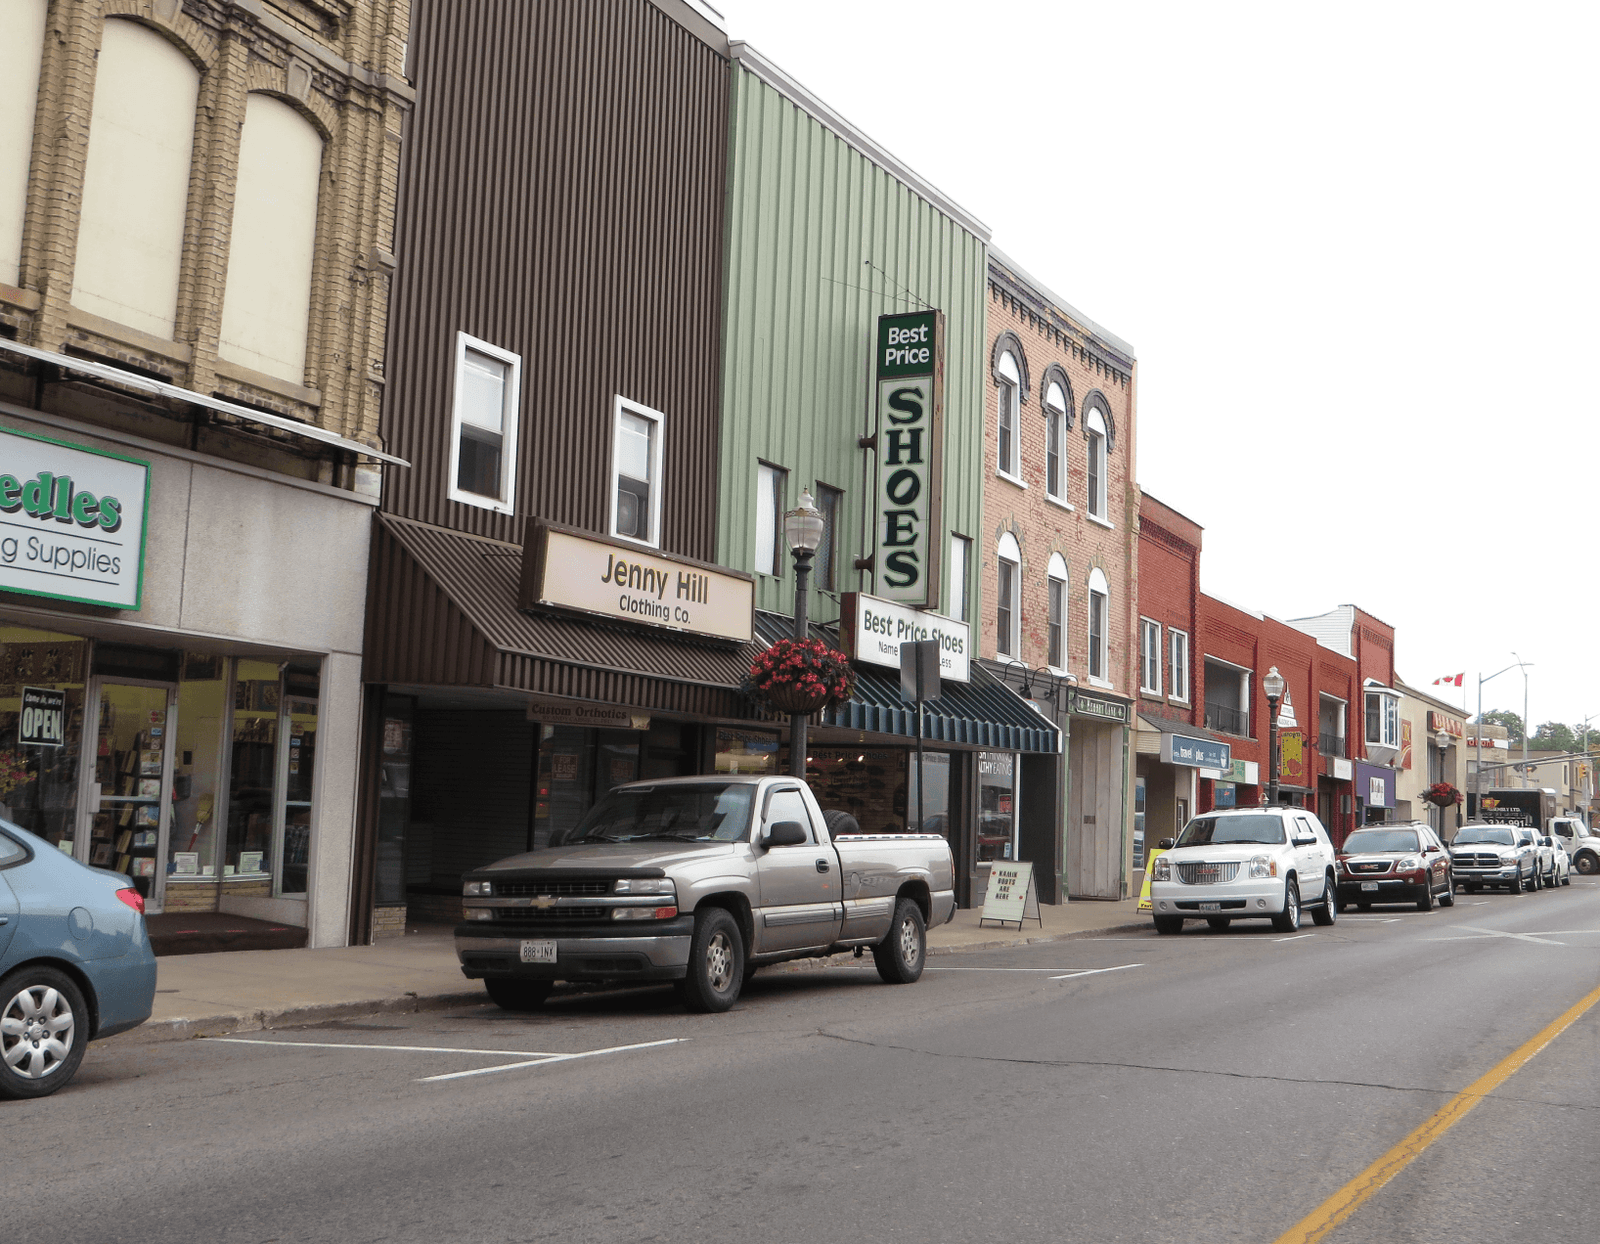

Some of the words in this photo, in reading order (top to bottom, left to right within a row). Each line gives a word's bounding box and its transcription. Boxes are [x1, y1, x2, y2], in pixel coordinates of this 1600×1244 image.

[888, 323, 928, 345] Best
[885, 346, 930, 367] Price
[883, 386, 925, 589] SHOES
[26, 536, 121, 575] Supplies
[600, 553, 669, 600] Jenny
[676, 571, 709, 605] Hill
[619, 594, 670, 622] Clothing
[674, 605, 691, 624] Co.
[864, 609, 893, 637] Best
[897, 618, 928, 642] Price
[931, 627, 964, 655] Shoes
[878, 640, 899, 657] Name
[940, 657, 952, 669] ess
[531, 703, 572, 717] Custom
[575, 706, 628, 720] Orthotics
[23, 706, 62, 740] OPEN
[559, 756, 571, 764] FOR
[813, 751, 833, 760] Best
[836, 752, 857, 760] Price
[553, 764, 576, 774] LEASE
[997, 878, 1016, 886] BOOTS
[999, 885, 1010, 893] ARE
[995, 893, 1010, 901] HERE
[523, 946, 536, 958] 888
